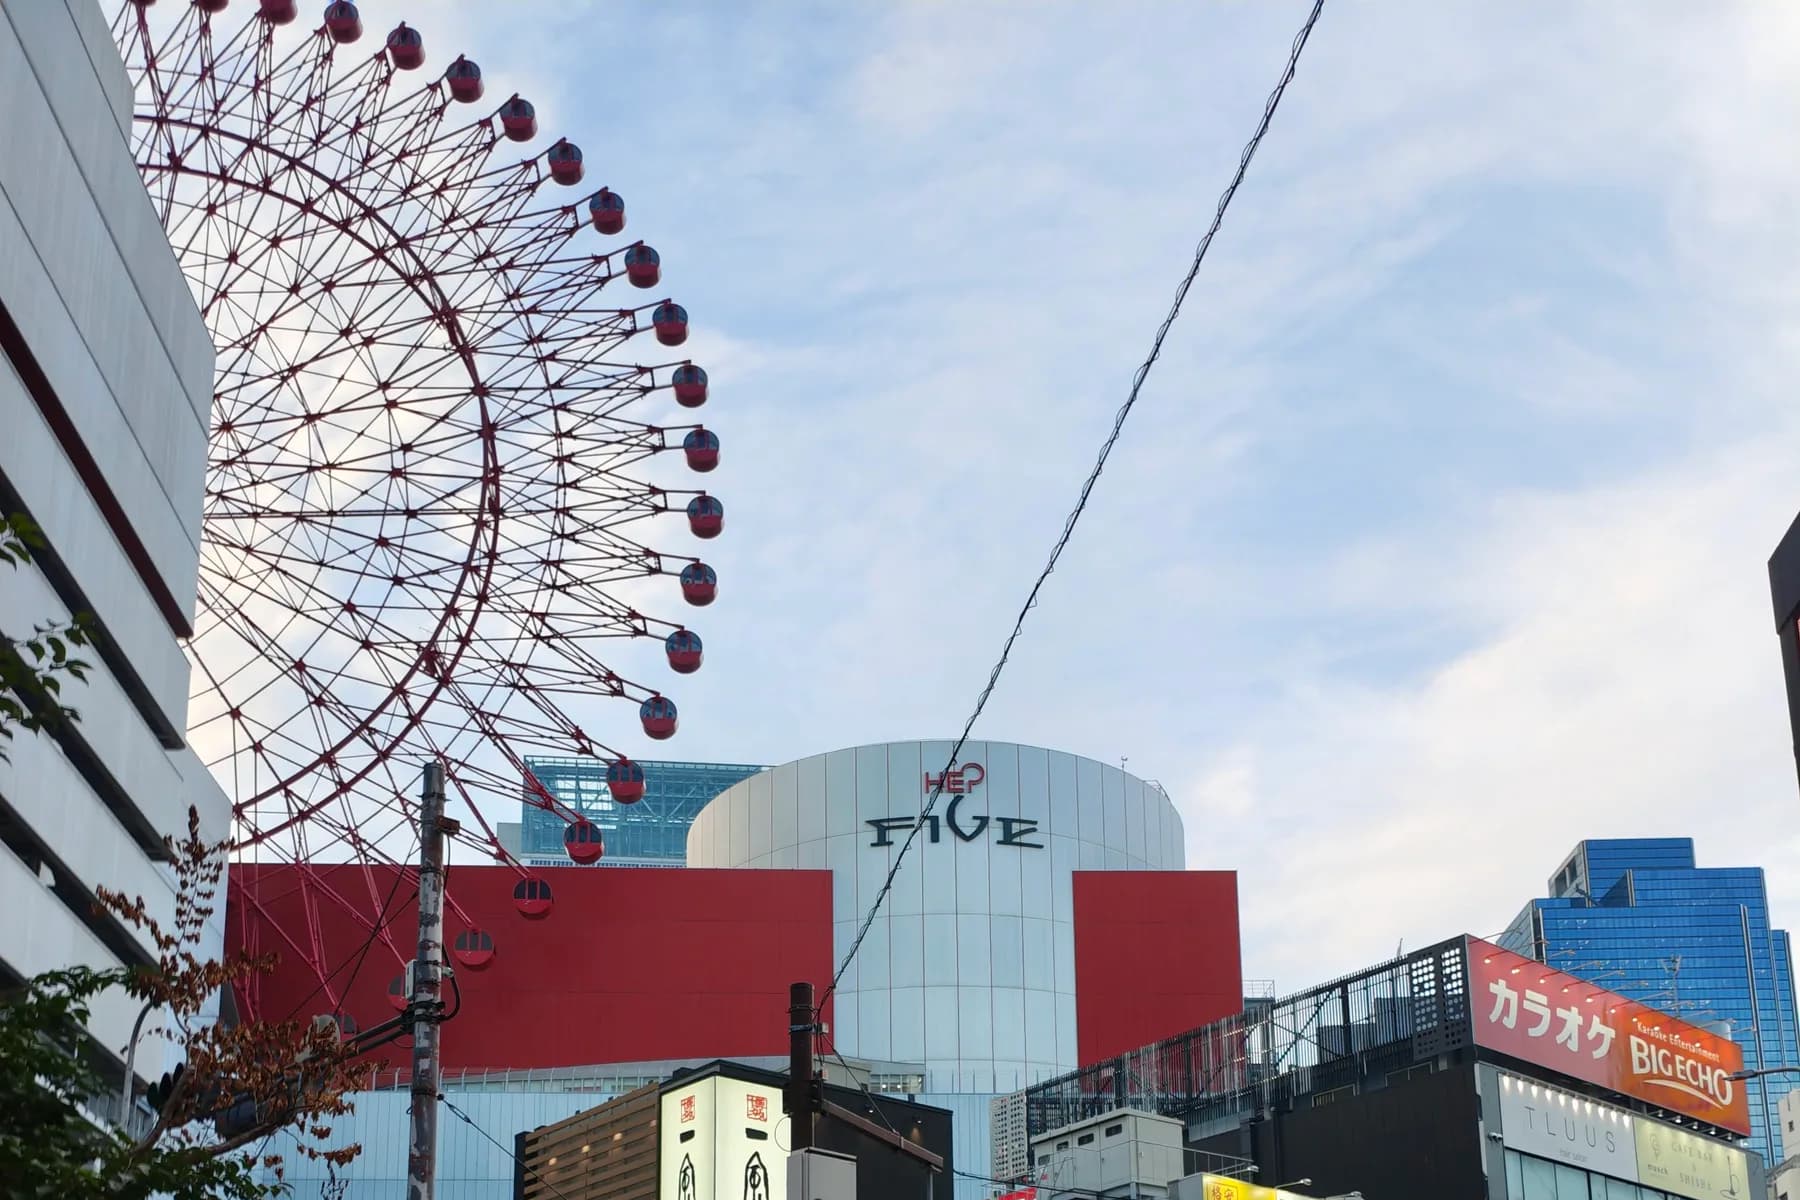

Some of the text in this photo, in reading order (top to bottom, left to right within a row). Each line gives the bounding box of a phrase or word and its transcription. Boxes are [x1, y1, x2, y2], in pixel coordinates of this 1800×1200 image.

[925, 762, 985, 794] HEP
[865, 794, 1044, 849] FIVE
[1488, 979, 1616, 1060] カラオケ
[1630, 1035, 1733, 1106] BIG ECHO
